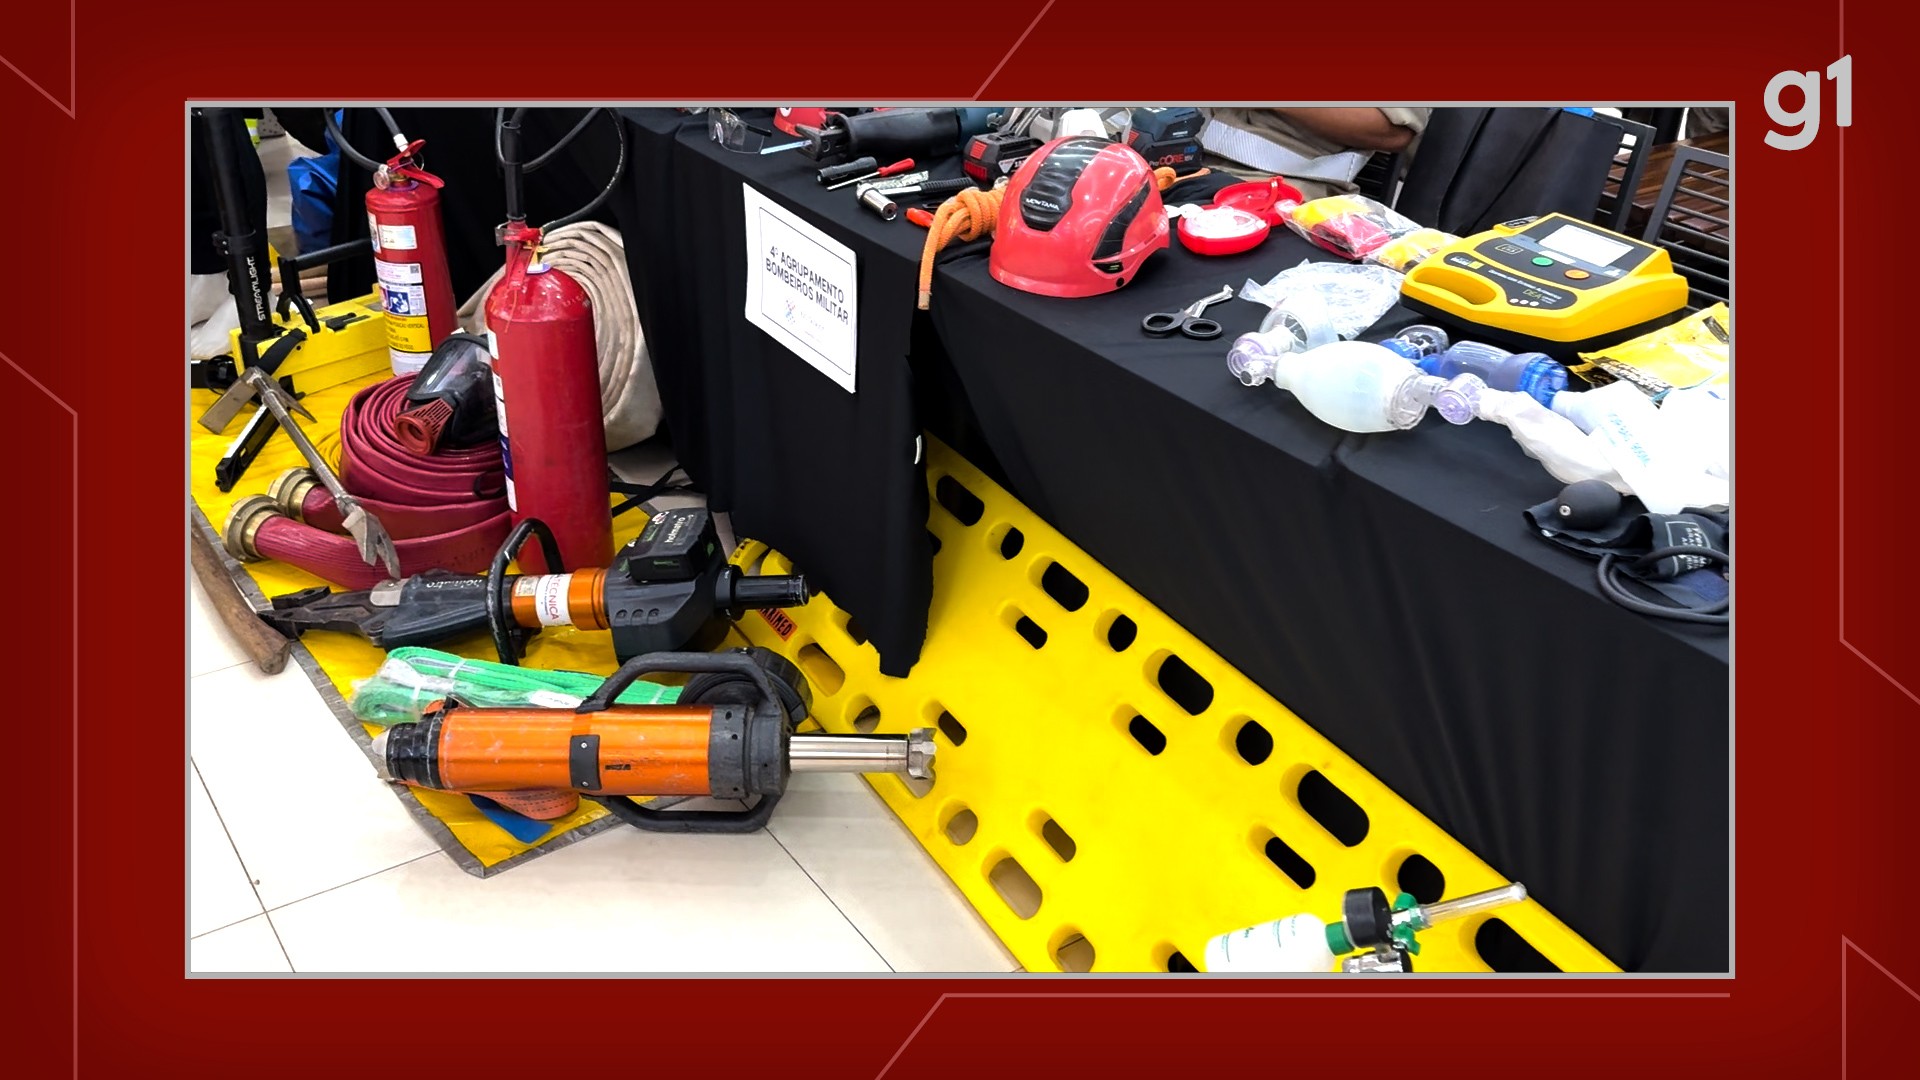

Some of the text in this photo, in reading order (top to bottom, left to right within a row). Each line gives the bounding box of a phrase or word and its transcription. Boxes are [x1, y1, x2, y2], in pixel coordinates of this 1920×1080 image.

[766, 257, 814, 301] BOMBEIROS
[815, 291, 849, 326] MILITAR
[780, 251, 845, 304] AGRUPAMENTO
[1522, 288, 1542, 299] DEA
